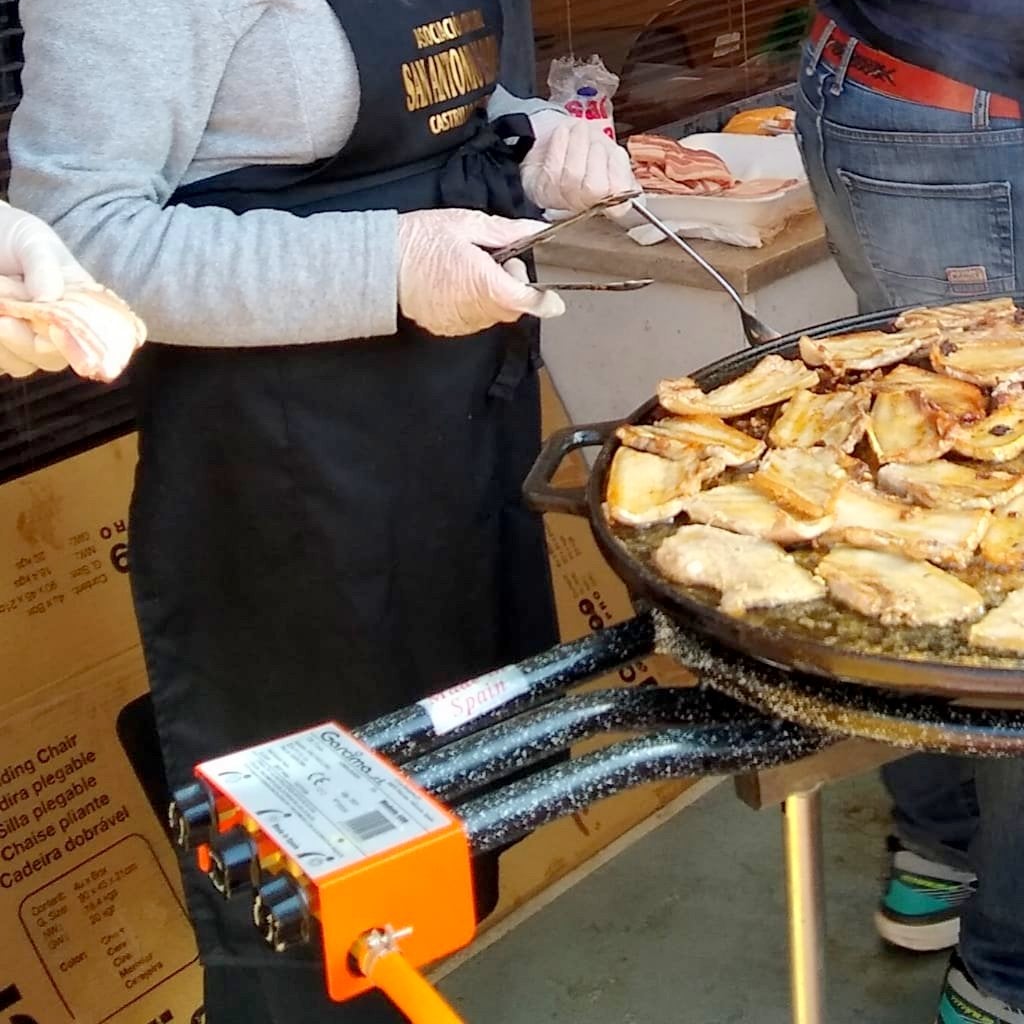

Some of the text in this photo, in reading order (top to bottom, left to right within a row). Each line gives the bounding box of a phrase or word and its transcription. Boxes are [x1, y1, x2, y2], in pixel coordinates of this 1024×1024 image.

[451, 680, 505, 717] Spain
[37, 734, 78, 764] Chair
[32, 751, 97, 796] plegable
[32, 776, 97, 822] plegable
[0, 794, 110, 861] Chaise pliante
[0, 805, 130, 889] Cadeira dobrável
